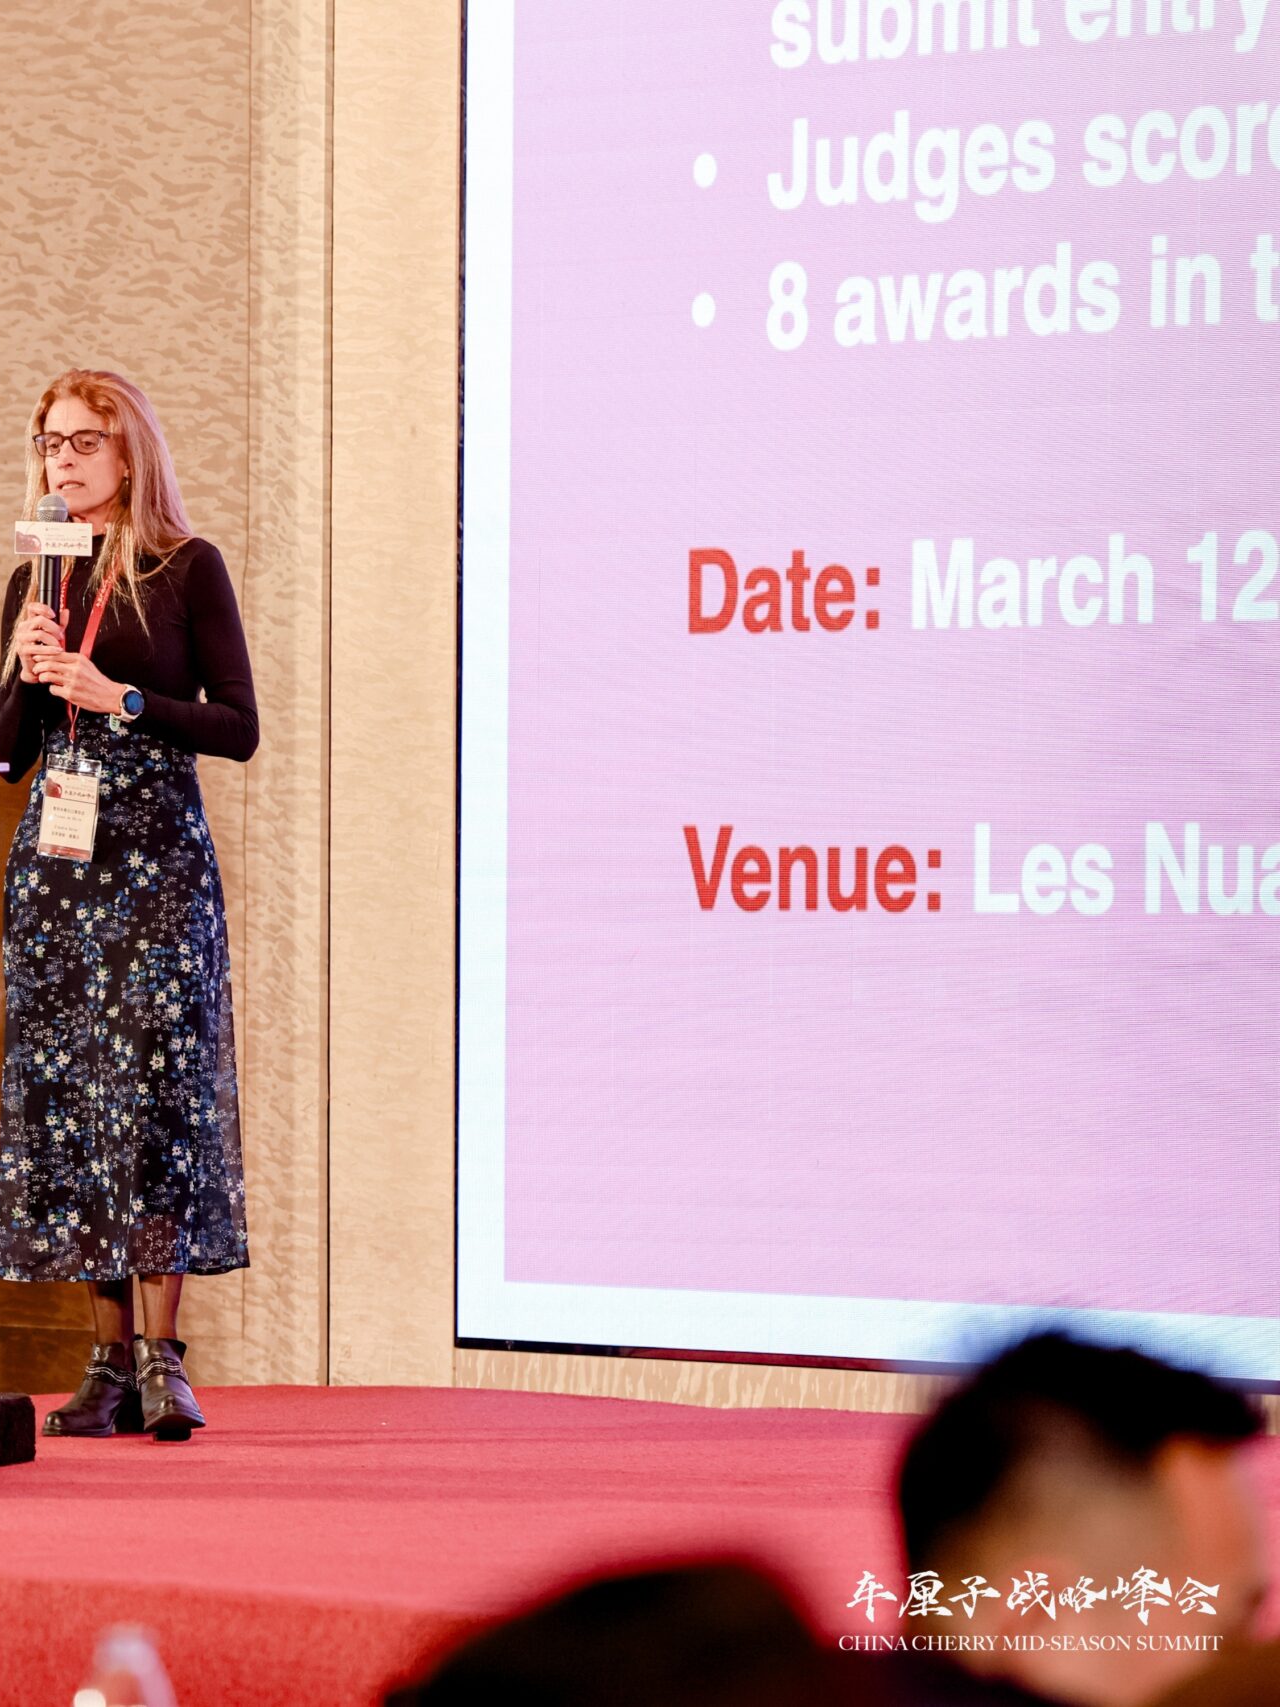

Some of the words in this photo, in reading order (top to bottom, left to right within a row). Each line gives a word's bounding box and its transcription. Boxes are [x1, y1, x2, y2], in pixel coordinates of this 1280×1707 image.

[766, 109, 1056, 224] Judges
[1082, 102, 1280, 188] scor
[765, 260, 810, 352] 8
[833, 241, 1121, 348] awards
[1150, 235, 1221, 328] in
[687, 546, 881, 635] Date:
[911, 533, 1154, 630] March
[1187, 529, 1280, 622] 12
[681, 824, 942, 914] Venue:
[973, 822, 1114, 916] Les
